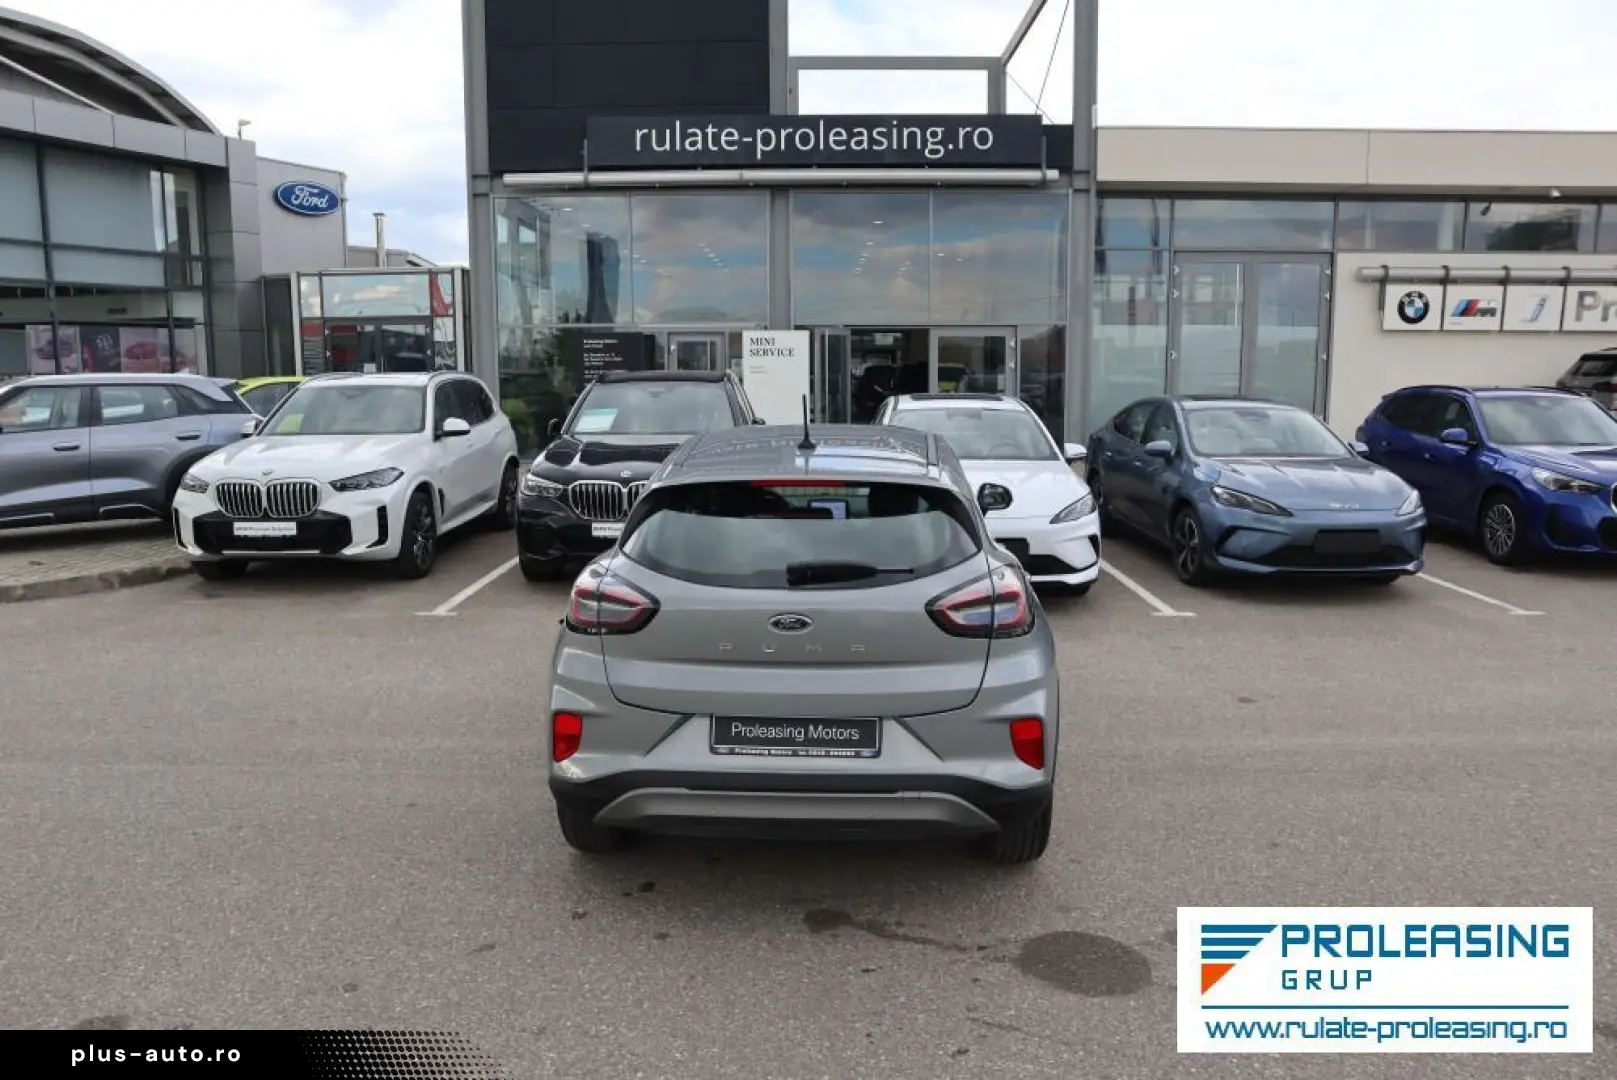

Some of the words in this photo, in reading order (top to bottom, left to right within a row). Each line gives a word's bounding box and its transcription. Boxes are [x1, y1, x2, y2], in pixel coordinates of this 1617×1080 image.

[634, 119, 995, 159] rulate-proleasing.ro
[290, 185, 329, 208] Ford
[1575, 290, 1617, 322] Pr
[749, 337, 776, 347] MINI
[749, 348, 795, 358] SERVICE
[718, 642, 866, 653] PUMA
[731, 722, 804, 741] Proleasing
[808, 724, 860, 740] Motors
